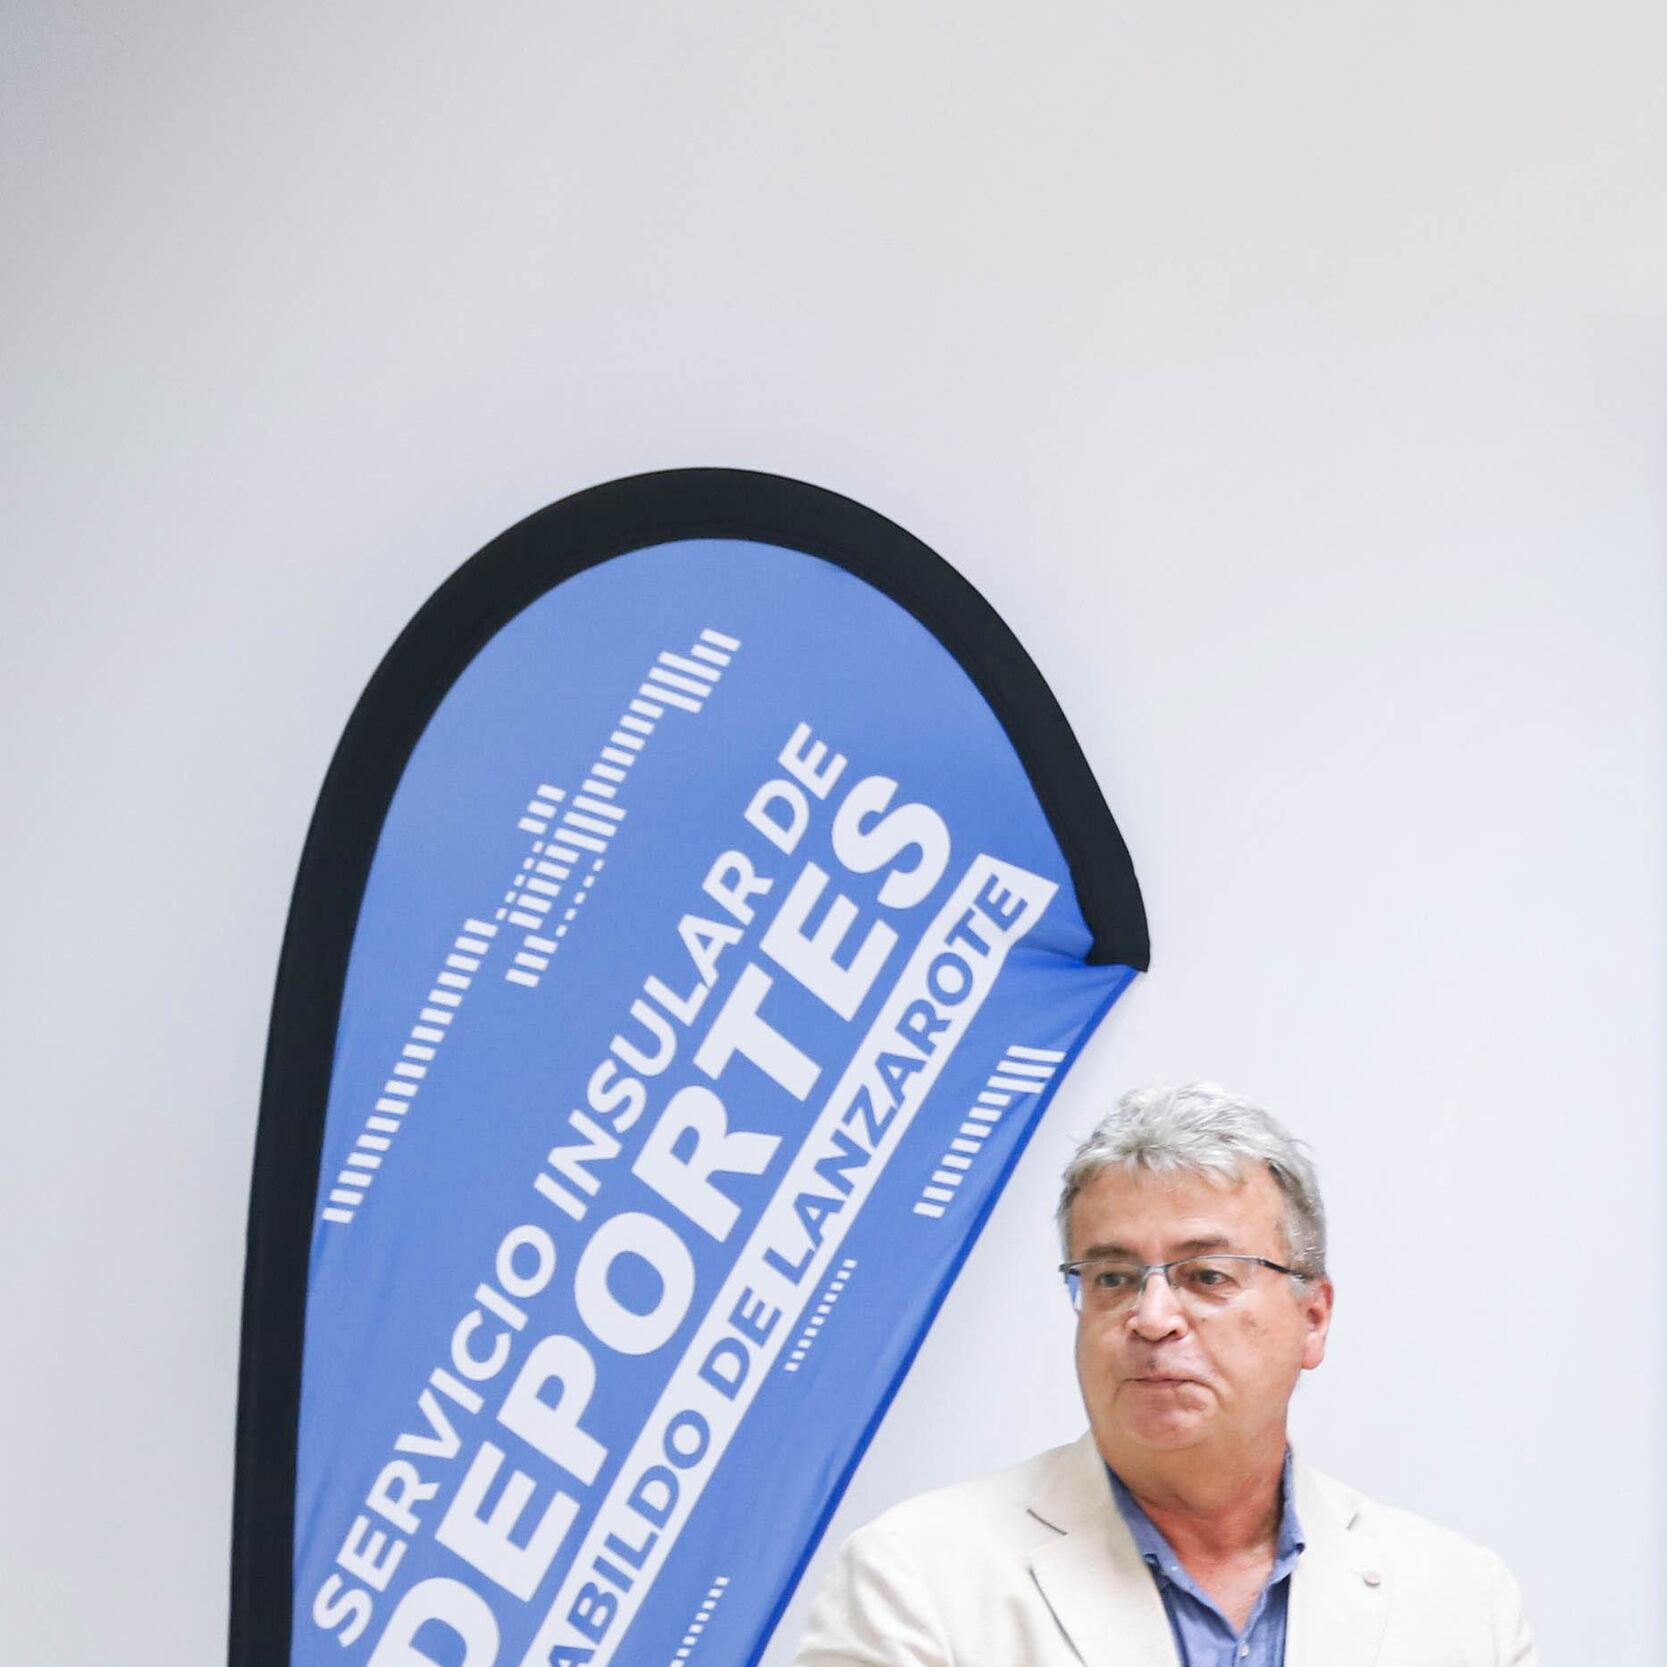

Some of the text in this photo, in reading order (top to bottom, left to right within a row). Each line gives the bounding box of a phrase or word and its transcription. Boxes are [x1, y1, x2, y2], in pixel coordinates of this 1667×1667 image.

[312, 721, 848, 1648] SERVICIO INSULAR DE
[697, 1287, 784, 1401] DE
[762, 874, 1030, 1285] LANZAROTE
